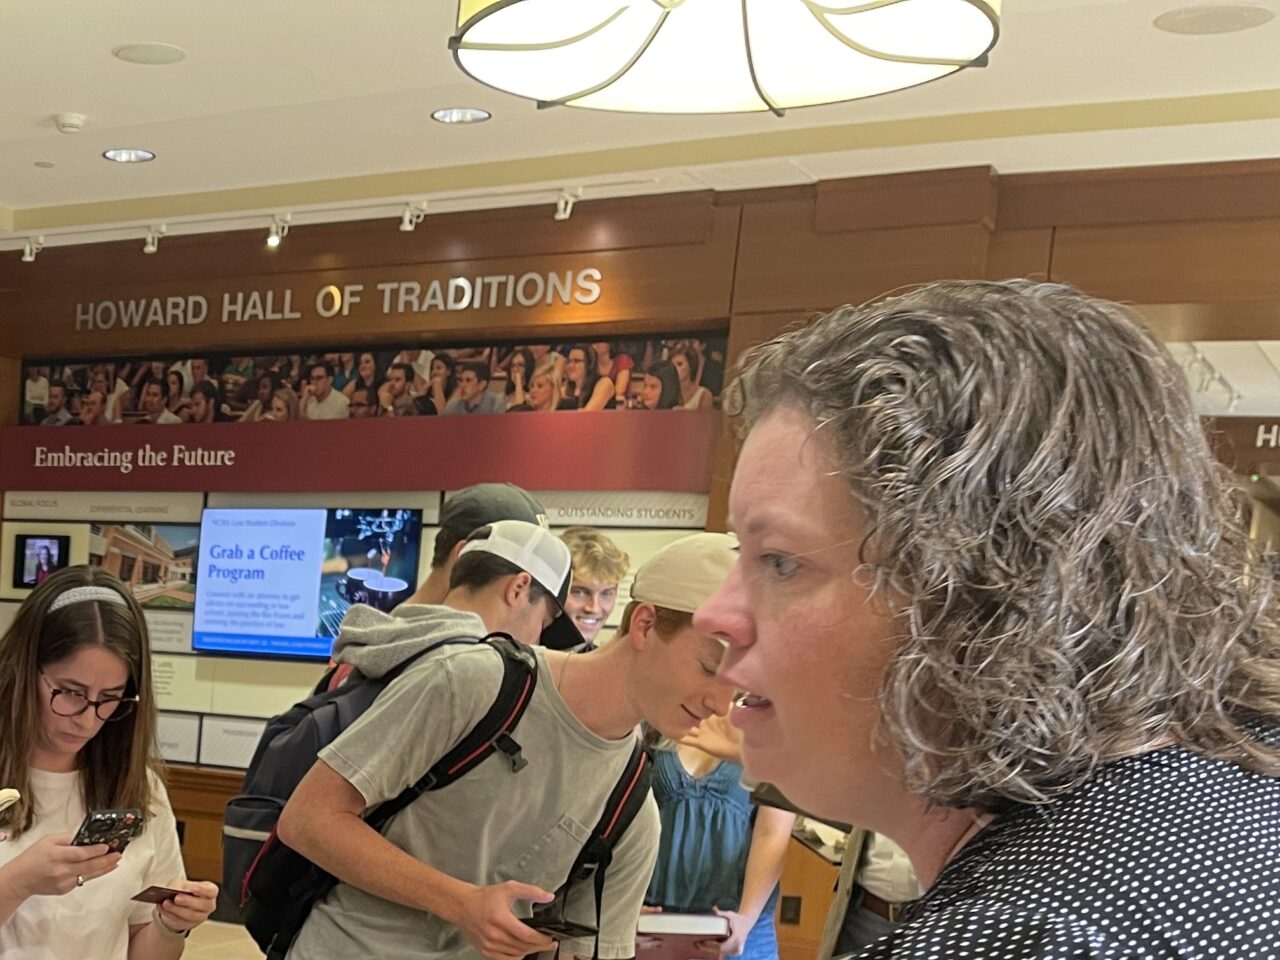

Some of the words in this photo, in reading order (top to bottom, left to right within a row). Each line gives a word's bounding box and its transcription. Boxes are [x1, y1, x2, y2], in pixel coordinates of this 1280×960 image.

[75, 295, 208, 331] HOWARD
[221, 289, 302, 322] HALL
[316, 284, 364, 318] OF
[377, 267, 603, 314] TRADITIONS
[34, 445, 134, 474] Embracing
[137, 444, 168, 467] the
[172, 444, 236, 467] Future
[558, 507, 633, 519] OUTSTANDING
[637, 508, 695, 520] STUDENTS
[210, 544, 243, 560] Grab
[247, 549, 256, 560] a
[259, 545, 306, 561] Coffee
[208, 564, 265, 584] Program
